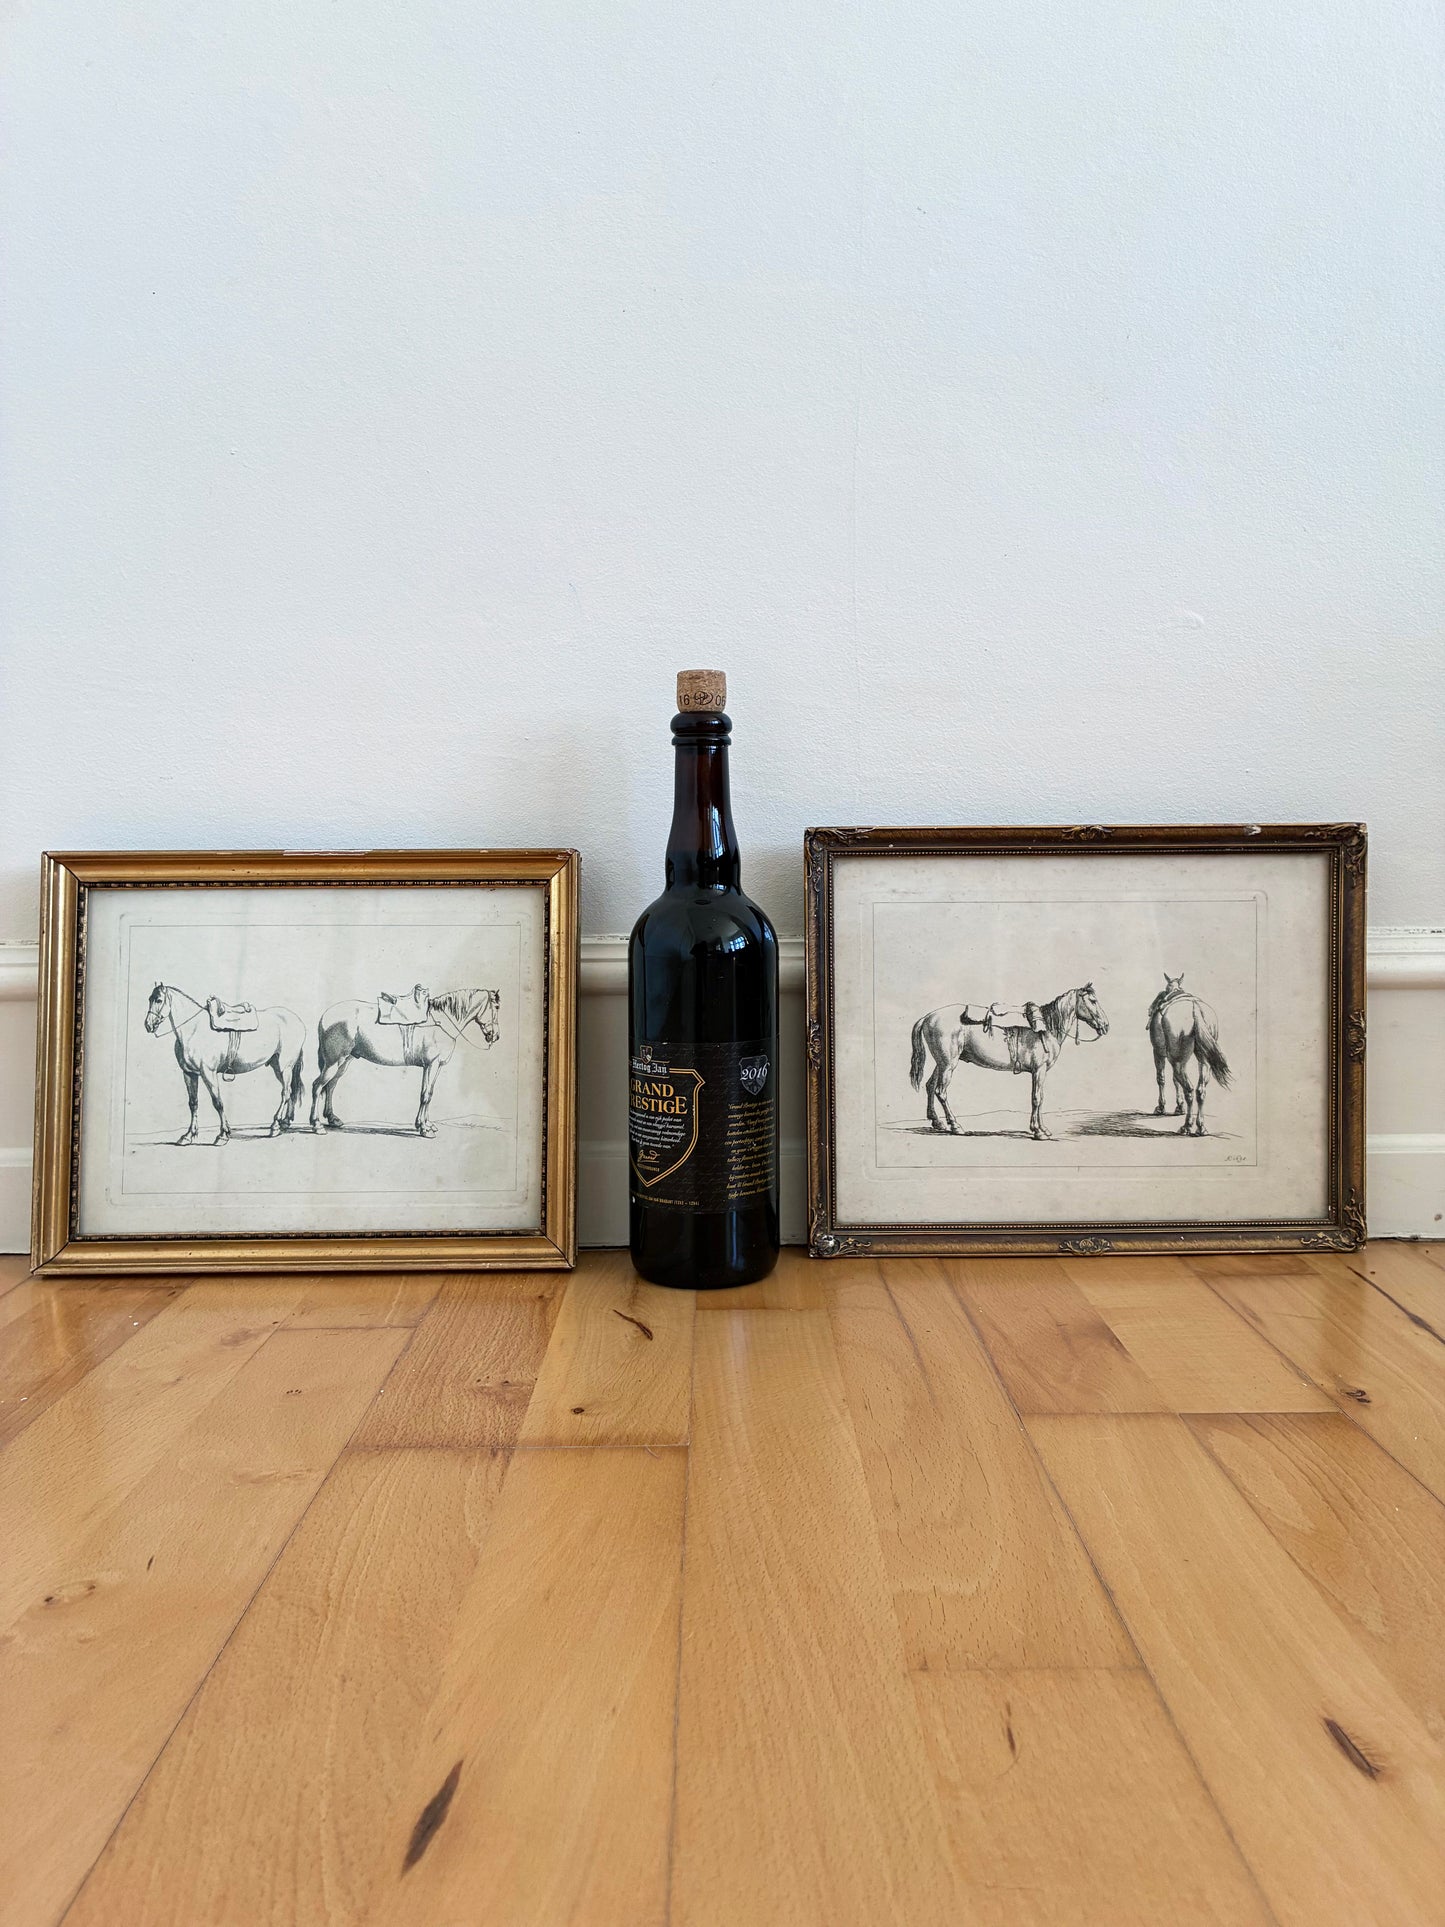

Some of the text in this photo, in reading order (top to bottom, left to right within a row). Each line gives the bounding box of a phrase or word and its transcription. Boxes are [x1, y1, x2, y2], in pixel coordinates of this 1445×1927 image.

[652, 1063, 667, 1075] Jan
[740, 1062, 770, 1080] 2016
[631, 1078, 675, 1097] GRAND
[631, 1094, 688, 1115] RESTIGE
